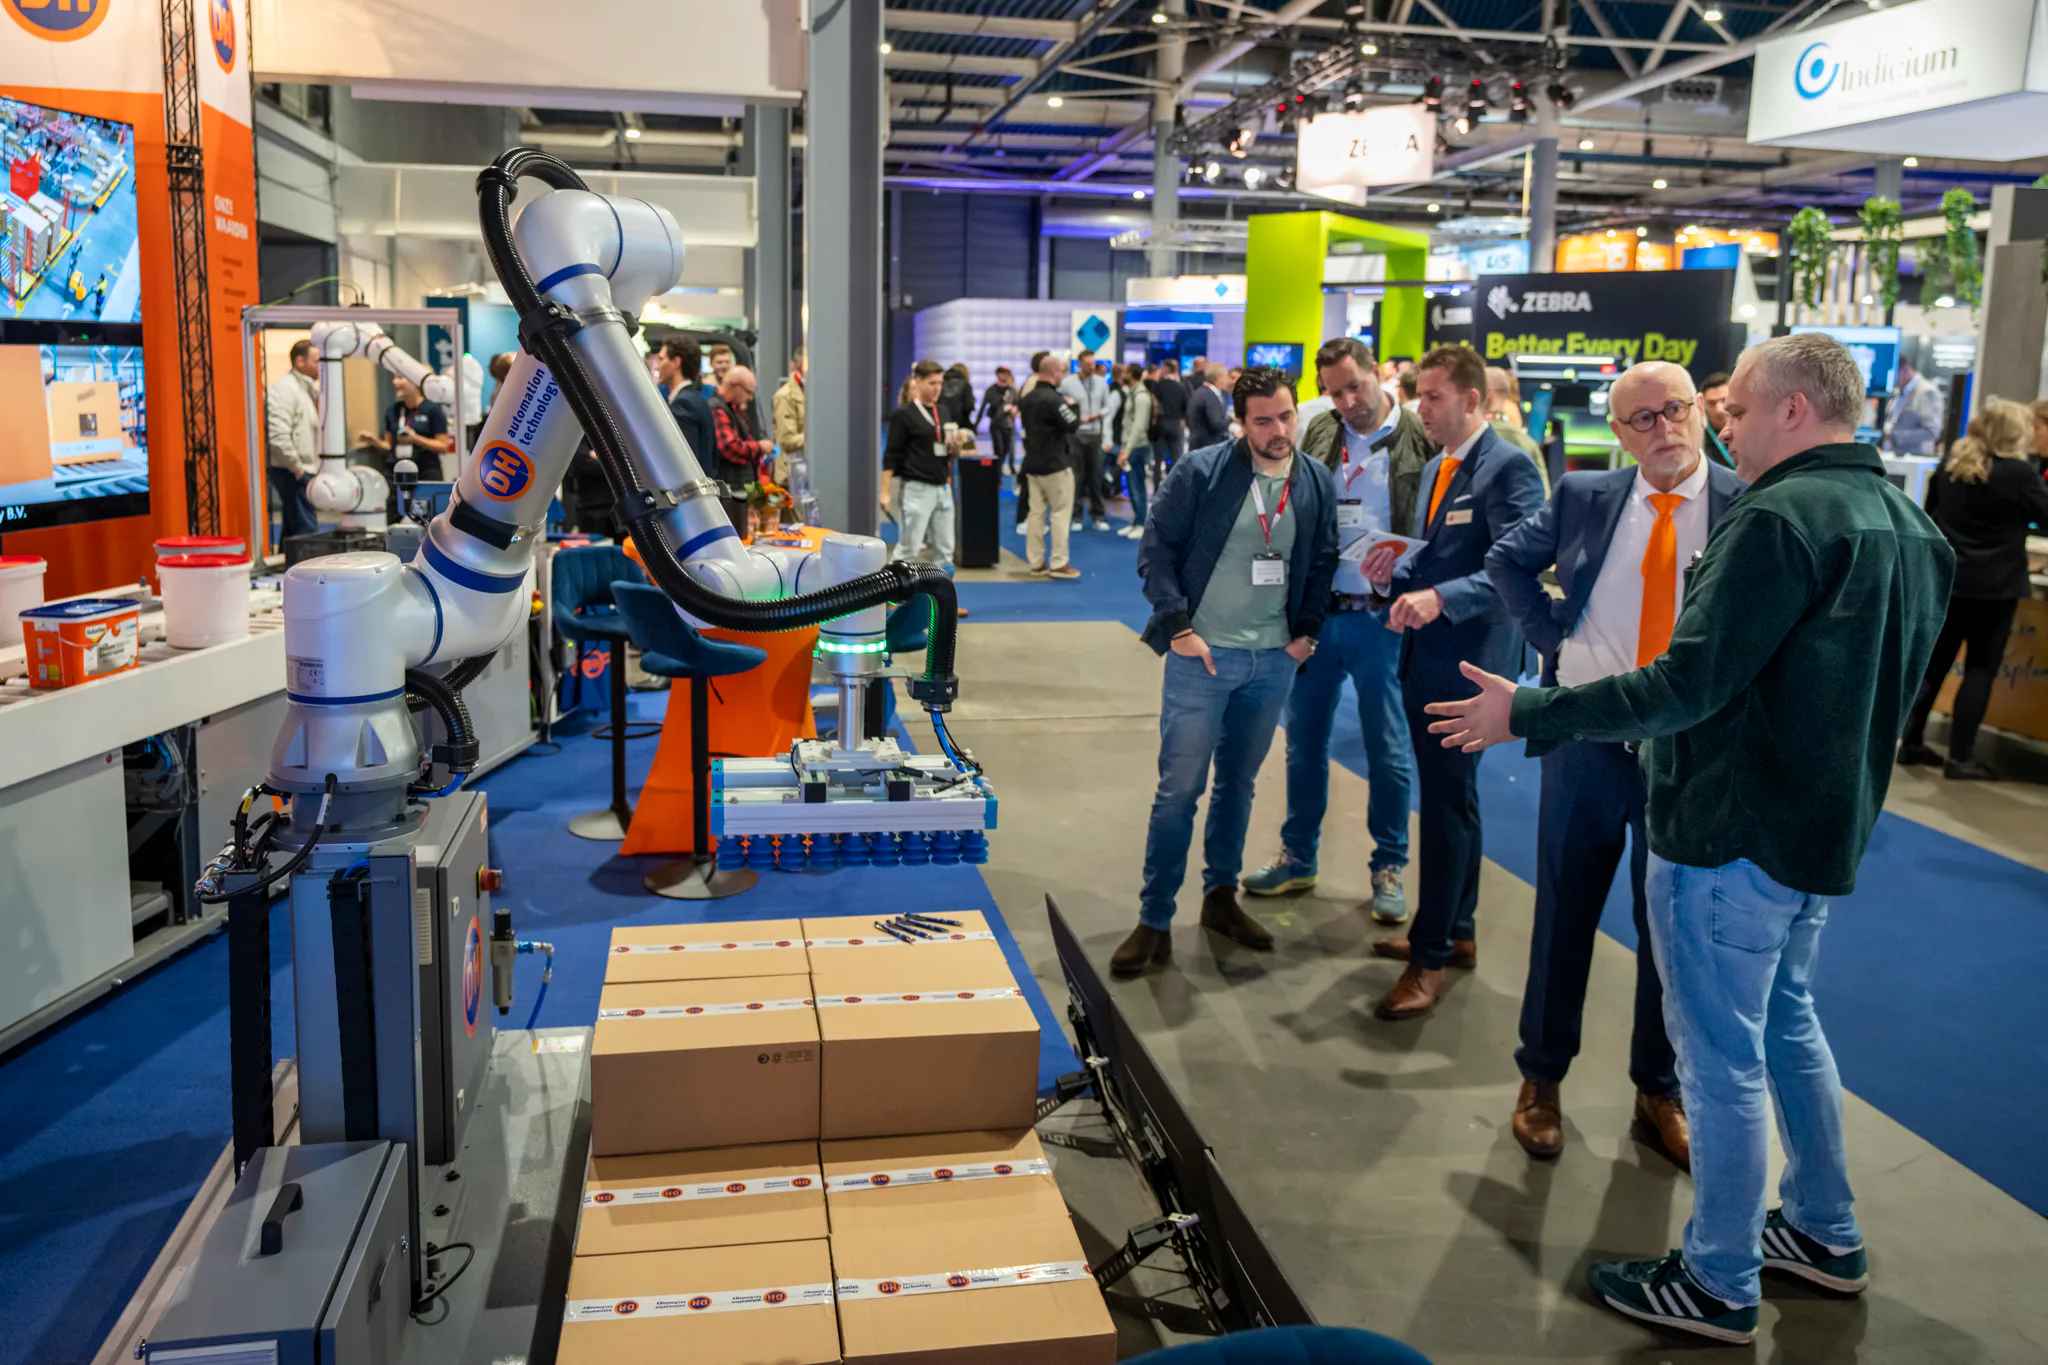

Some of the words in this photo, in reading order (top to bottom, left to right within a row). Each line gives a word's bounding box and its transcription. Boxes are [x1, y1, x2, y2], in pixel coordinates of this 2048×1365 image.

[1841, 46, 1959, 92] Indicium
[1349, 134, 1419, 158] ZEA
[1521, 291, 1592, 313] ZEBRA
[1485, 332, 1564, 360] Better
[1566, 331, 1641, 367] Every
[1643, 332, 1698, 368] Day
[507, 368, 546, 438] automation
[519, 376, 560, 446] technology
[485, 449, 521, 495] DH
[6, 505, 28, 520] B.V.
